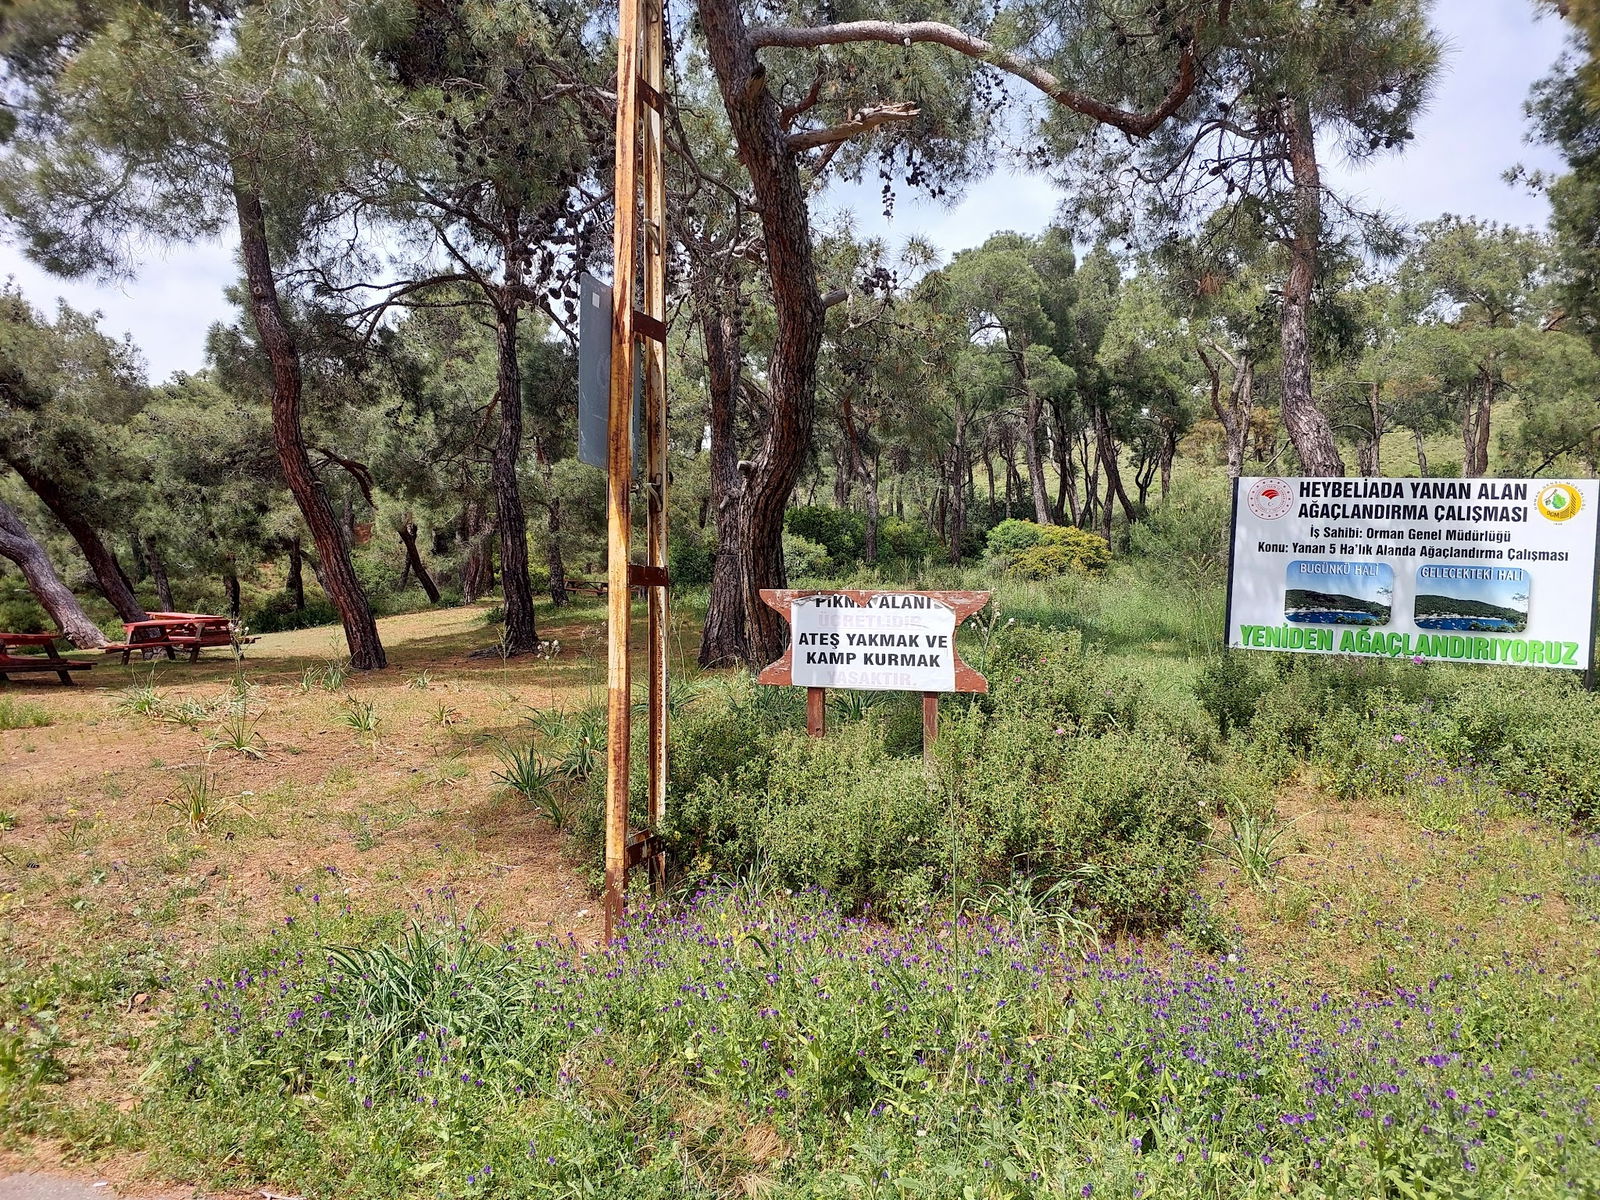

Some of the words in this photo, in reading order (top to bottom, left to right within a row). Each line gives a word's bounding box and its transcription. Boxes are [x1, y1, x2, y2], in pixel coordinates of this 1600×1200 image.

[1299, 478, 1404, 499] HEYBELİADA
[1410, 482, 1471, 500] YANAN
[1477, 483, 1528, 501] ALAN
[1298, 500, 1429, 521] AĞAÇLANDIRMA
[1434, 505, 1528, 523] ÇALIŞMASI
[1310, 524, 1320, 539] İş
[1323, 526, 1363, 539] Sahibi:
[1366, 527, 1404, 540] Orman
[1408, 528, 1442, 541] Genel
[1445, 529, 1511, 543] Müdürlüğü
[1258, 541, 1289, 553] Konu:
[1292, 542, 1326, 554] Yanan
[1329, 543, 1336, 554] 5
[1376, 544, 1416, 557] Alanda
[1420, 545, 1503, 560] Ağaçlandırma
[1507, 547, 1569, 562] Çalışması
[1299, 562, 1351, 575] BUGÜNKÜ
[1354, 562, 1379, 576] HALİ
[1420, 567, 1493, 581] GELECEKTEKİ
[1497, 567, 1524, 581] HALİ
[879, 596, 931, 609] ALANI
[798, 632, 840, 649] ATEŞ
[846, 633, 920, 648] YAKMAK
[926, 635, 948, 648] VE
[1239, 624, 1334, 652] YENİDEN
[1339, 627, 1579, 666] AĞAÇLANDIRIYORUZ
[806, 652, 857, 665] KAMP
[863, 653, 941, 668] KURMAK
